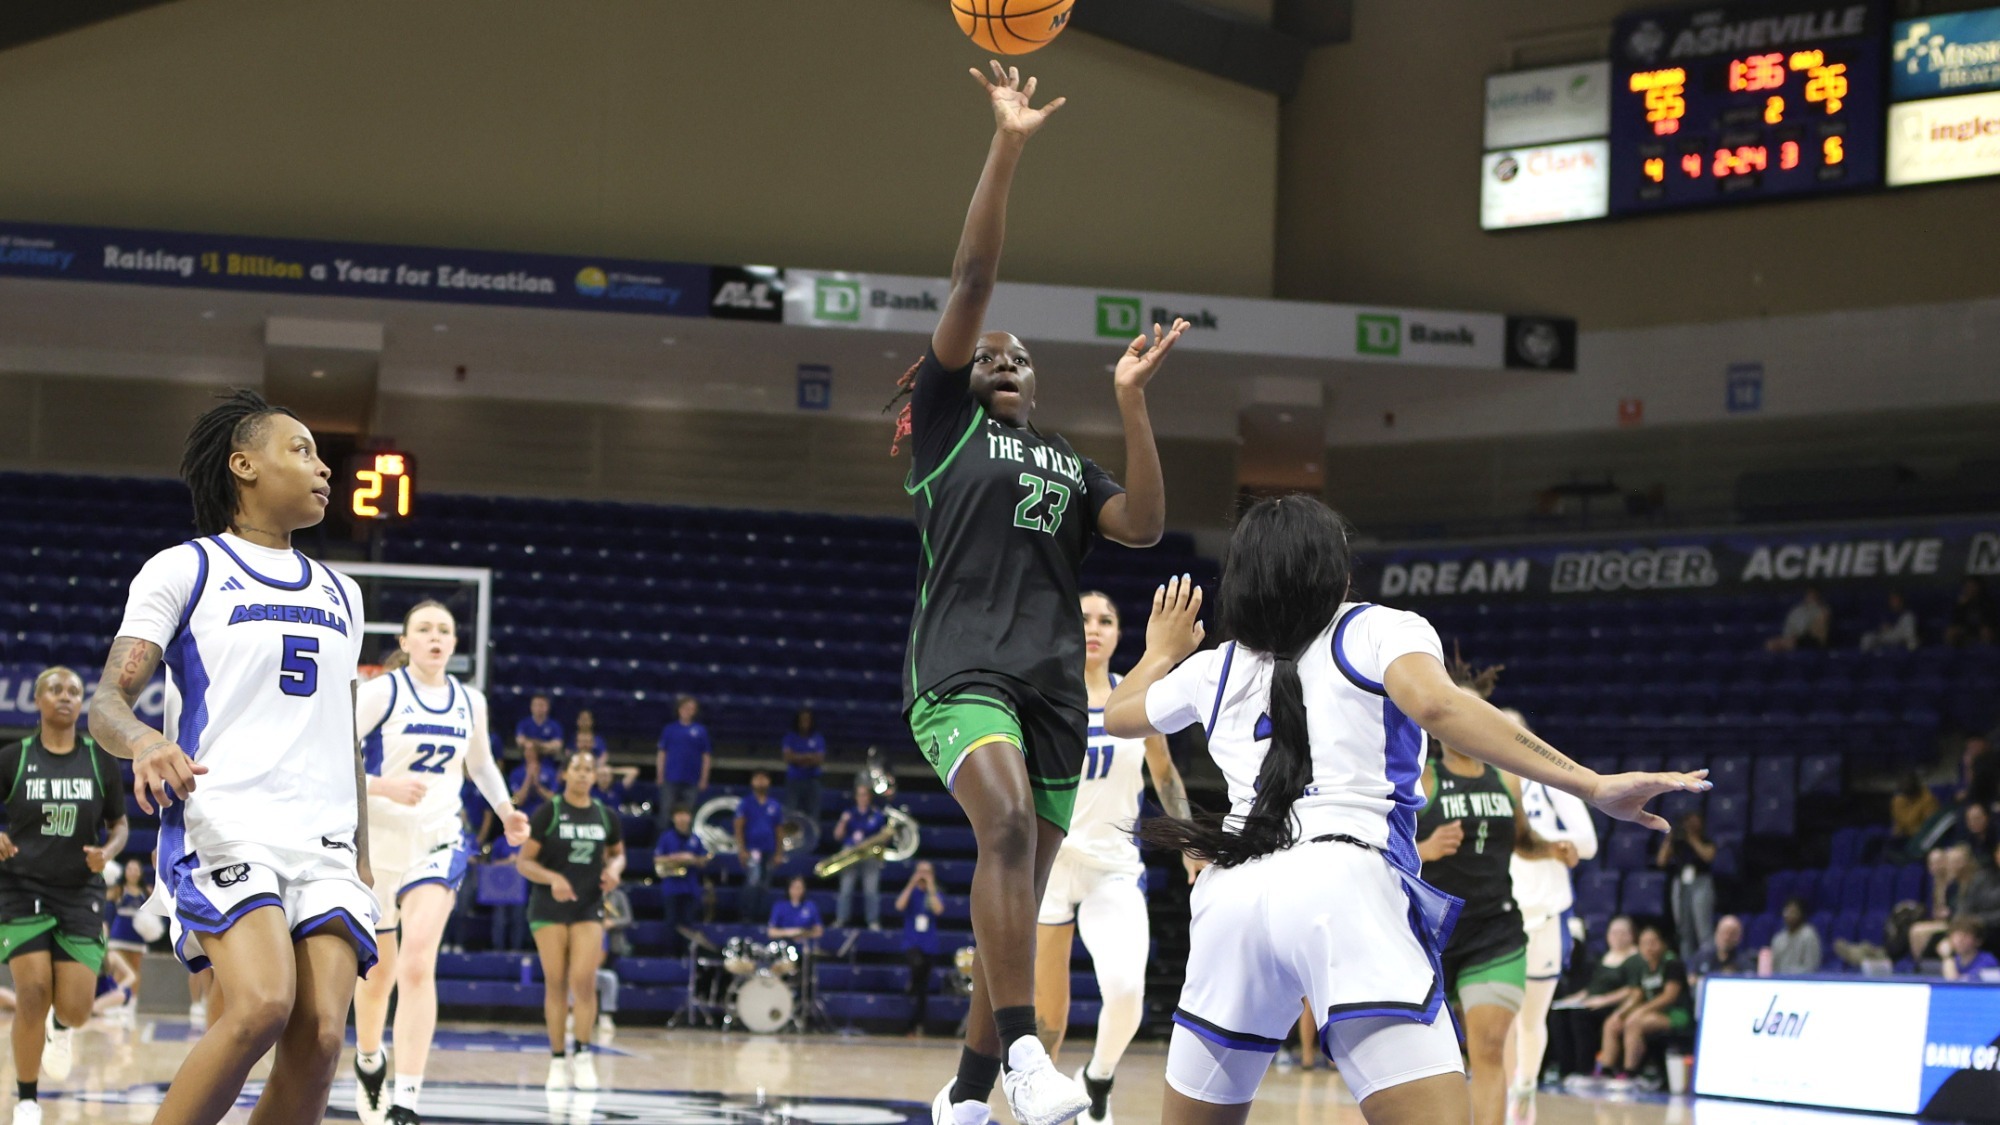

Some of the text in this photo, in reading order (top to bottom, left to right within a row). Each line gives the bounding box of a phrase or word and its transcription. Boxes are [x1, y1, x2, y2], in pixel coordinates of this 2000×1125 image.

[1670, 7, 1866, 58] ASHEVILLE
[1764, 95, 1785, 124] 2
[104, 244, 194, 277] Raising
[227, 253, 304, 280] Billion
[309, 264, 327, 281] a
[334, 259, 391, 284] Year
[396, 264, 431, 286] for
[436, 265, 556, 294] Education
[817, 282, 938, 316] TD Bank
[1100, 300, 1139, 333] TD
[1360, 318, 1475, 352] TD Bank
[987, 432, 1024, 463] THE
[353, 470, 410, 516] 21
[1014, 472, 1070, 537] 23
[1380, 558, 1531, 597] DREAM
[1741, 538, 1943, 582] ACHIEVE
[228, 603, 348, 638] ASHEVILLE
[279, 634, 319, 697] 5
[408, 743, 456, 774] 22
[1086, 745, 1115, 780] 11
[1515, 733, 1575, 773] UNDENIABLE
[25, 778, 94, 800] THE WILSON
[1440, 792, 1514, 819] THE WILSON
[41, 803, 78, 837] 30
[559, 823, 575, 839] THE
[1924, 1042, 1972, 1069] BANK
